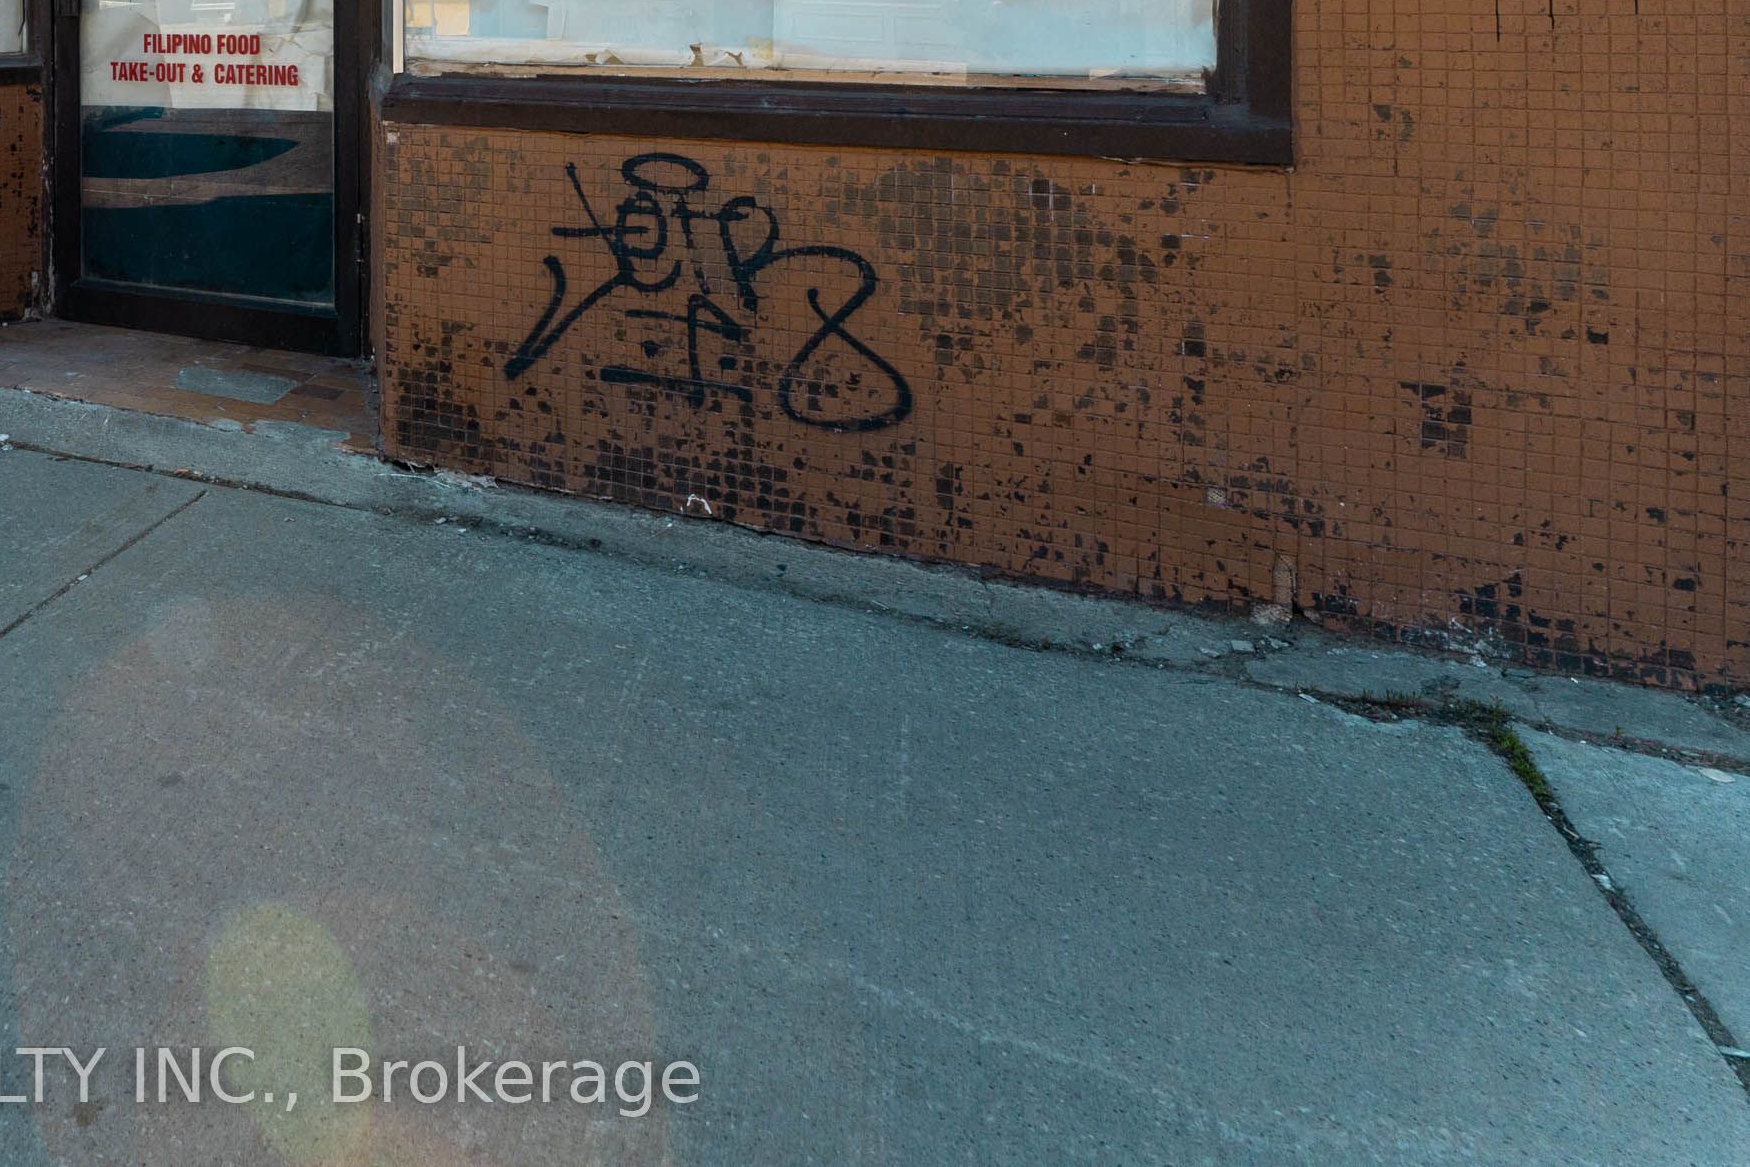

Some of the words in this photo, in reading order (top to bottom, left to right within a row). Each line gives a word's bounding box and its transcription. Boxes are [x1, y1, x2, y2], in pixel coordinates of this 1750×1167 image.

[143, 33, 212, 55] FILIPINO
[217, 34, 261, 55] FOOD
[110, 61, 186, 83] TAKE-OUT
[191, 63, 204, 84] &
[214, 63, 299, 86] CATERING
